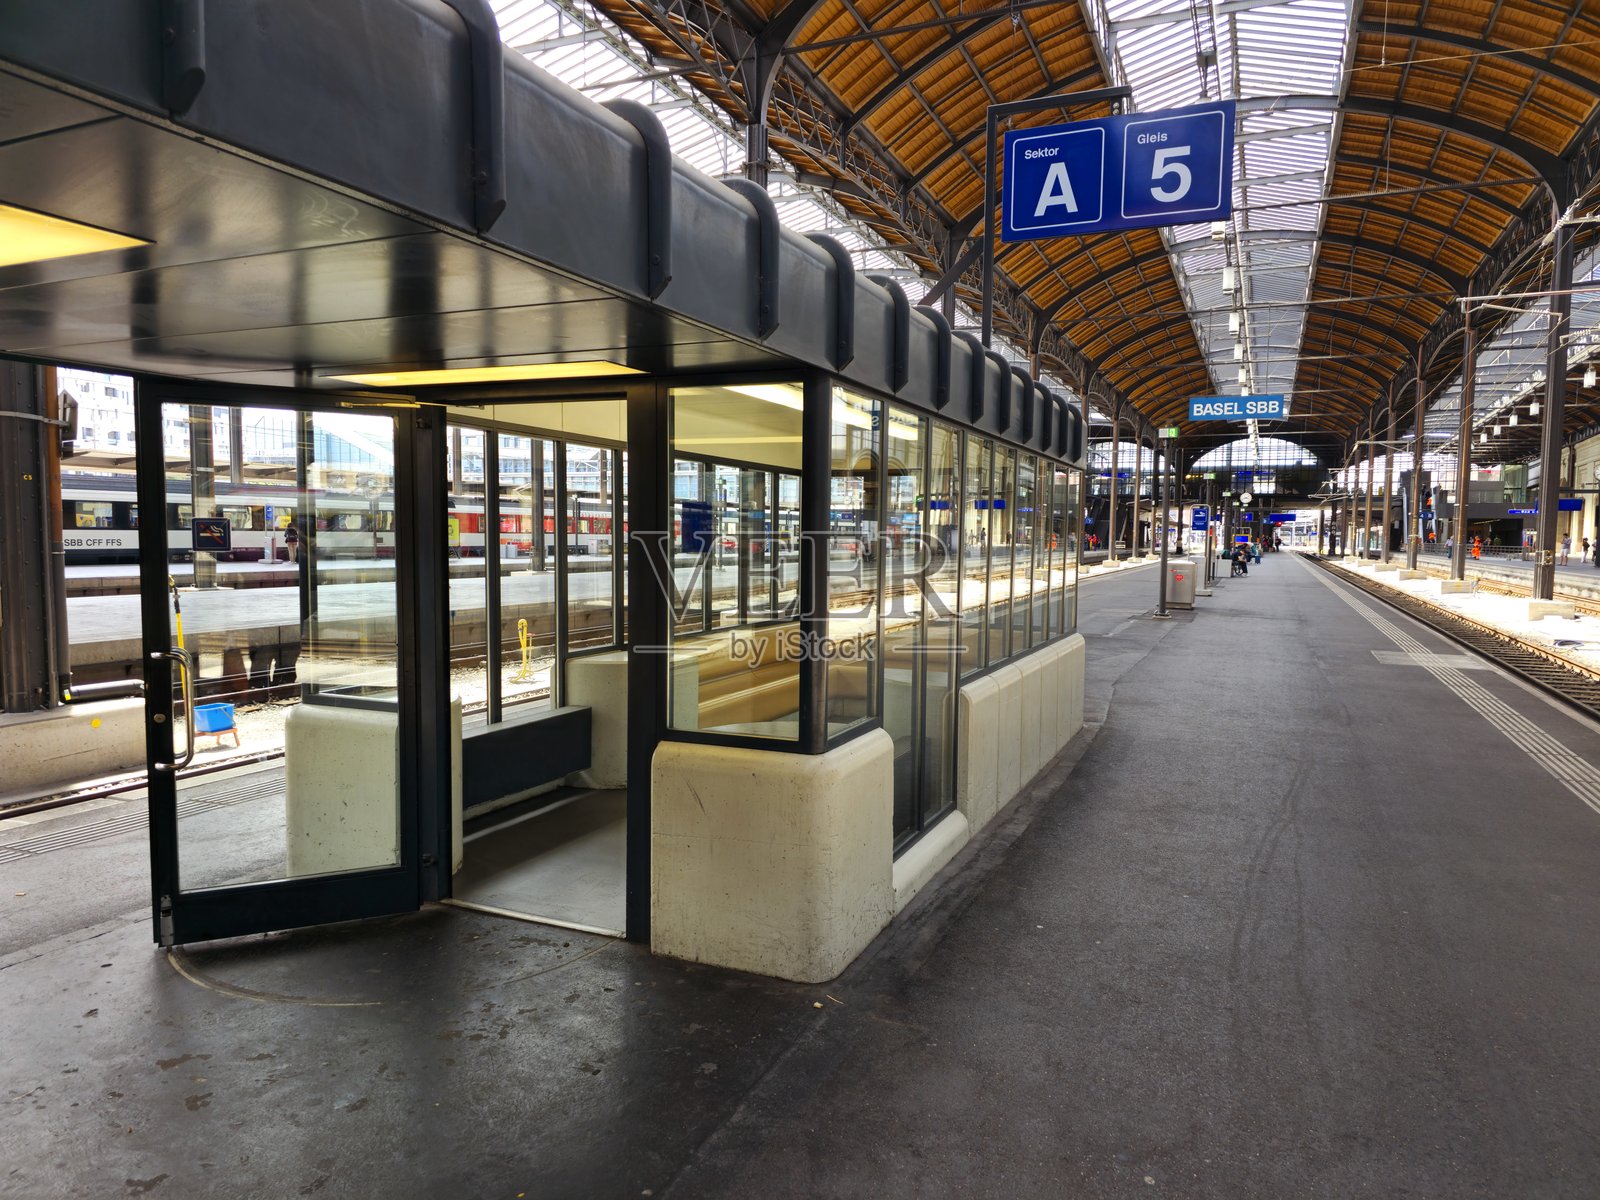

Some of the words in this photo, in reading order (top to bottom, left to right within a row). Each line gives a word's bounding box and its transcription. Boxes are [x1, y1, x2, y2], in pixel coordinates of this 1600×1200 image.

[1137, 131, 1168, 145] Gleis
[1024, 146, 1060, 160] Sektor
[1150, 145, 1192, 203] 5
[1033, 162, 1079, 217] A
[1193, 402, 1243, 417] BASEL
[1246, 400, 1280, 415] SBB
[64, 538, 83, 547] SBB
[86, 538, 103, 547] CFF
[106, 538, 122, 547] FFS
